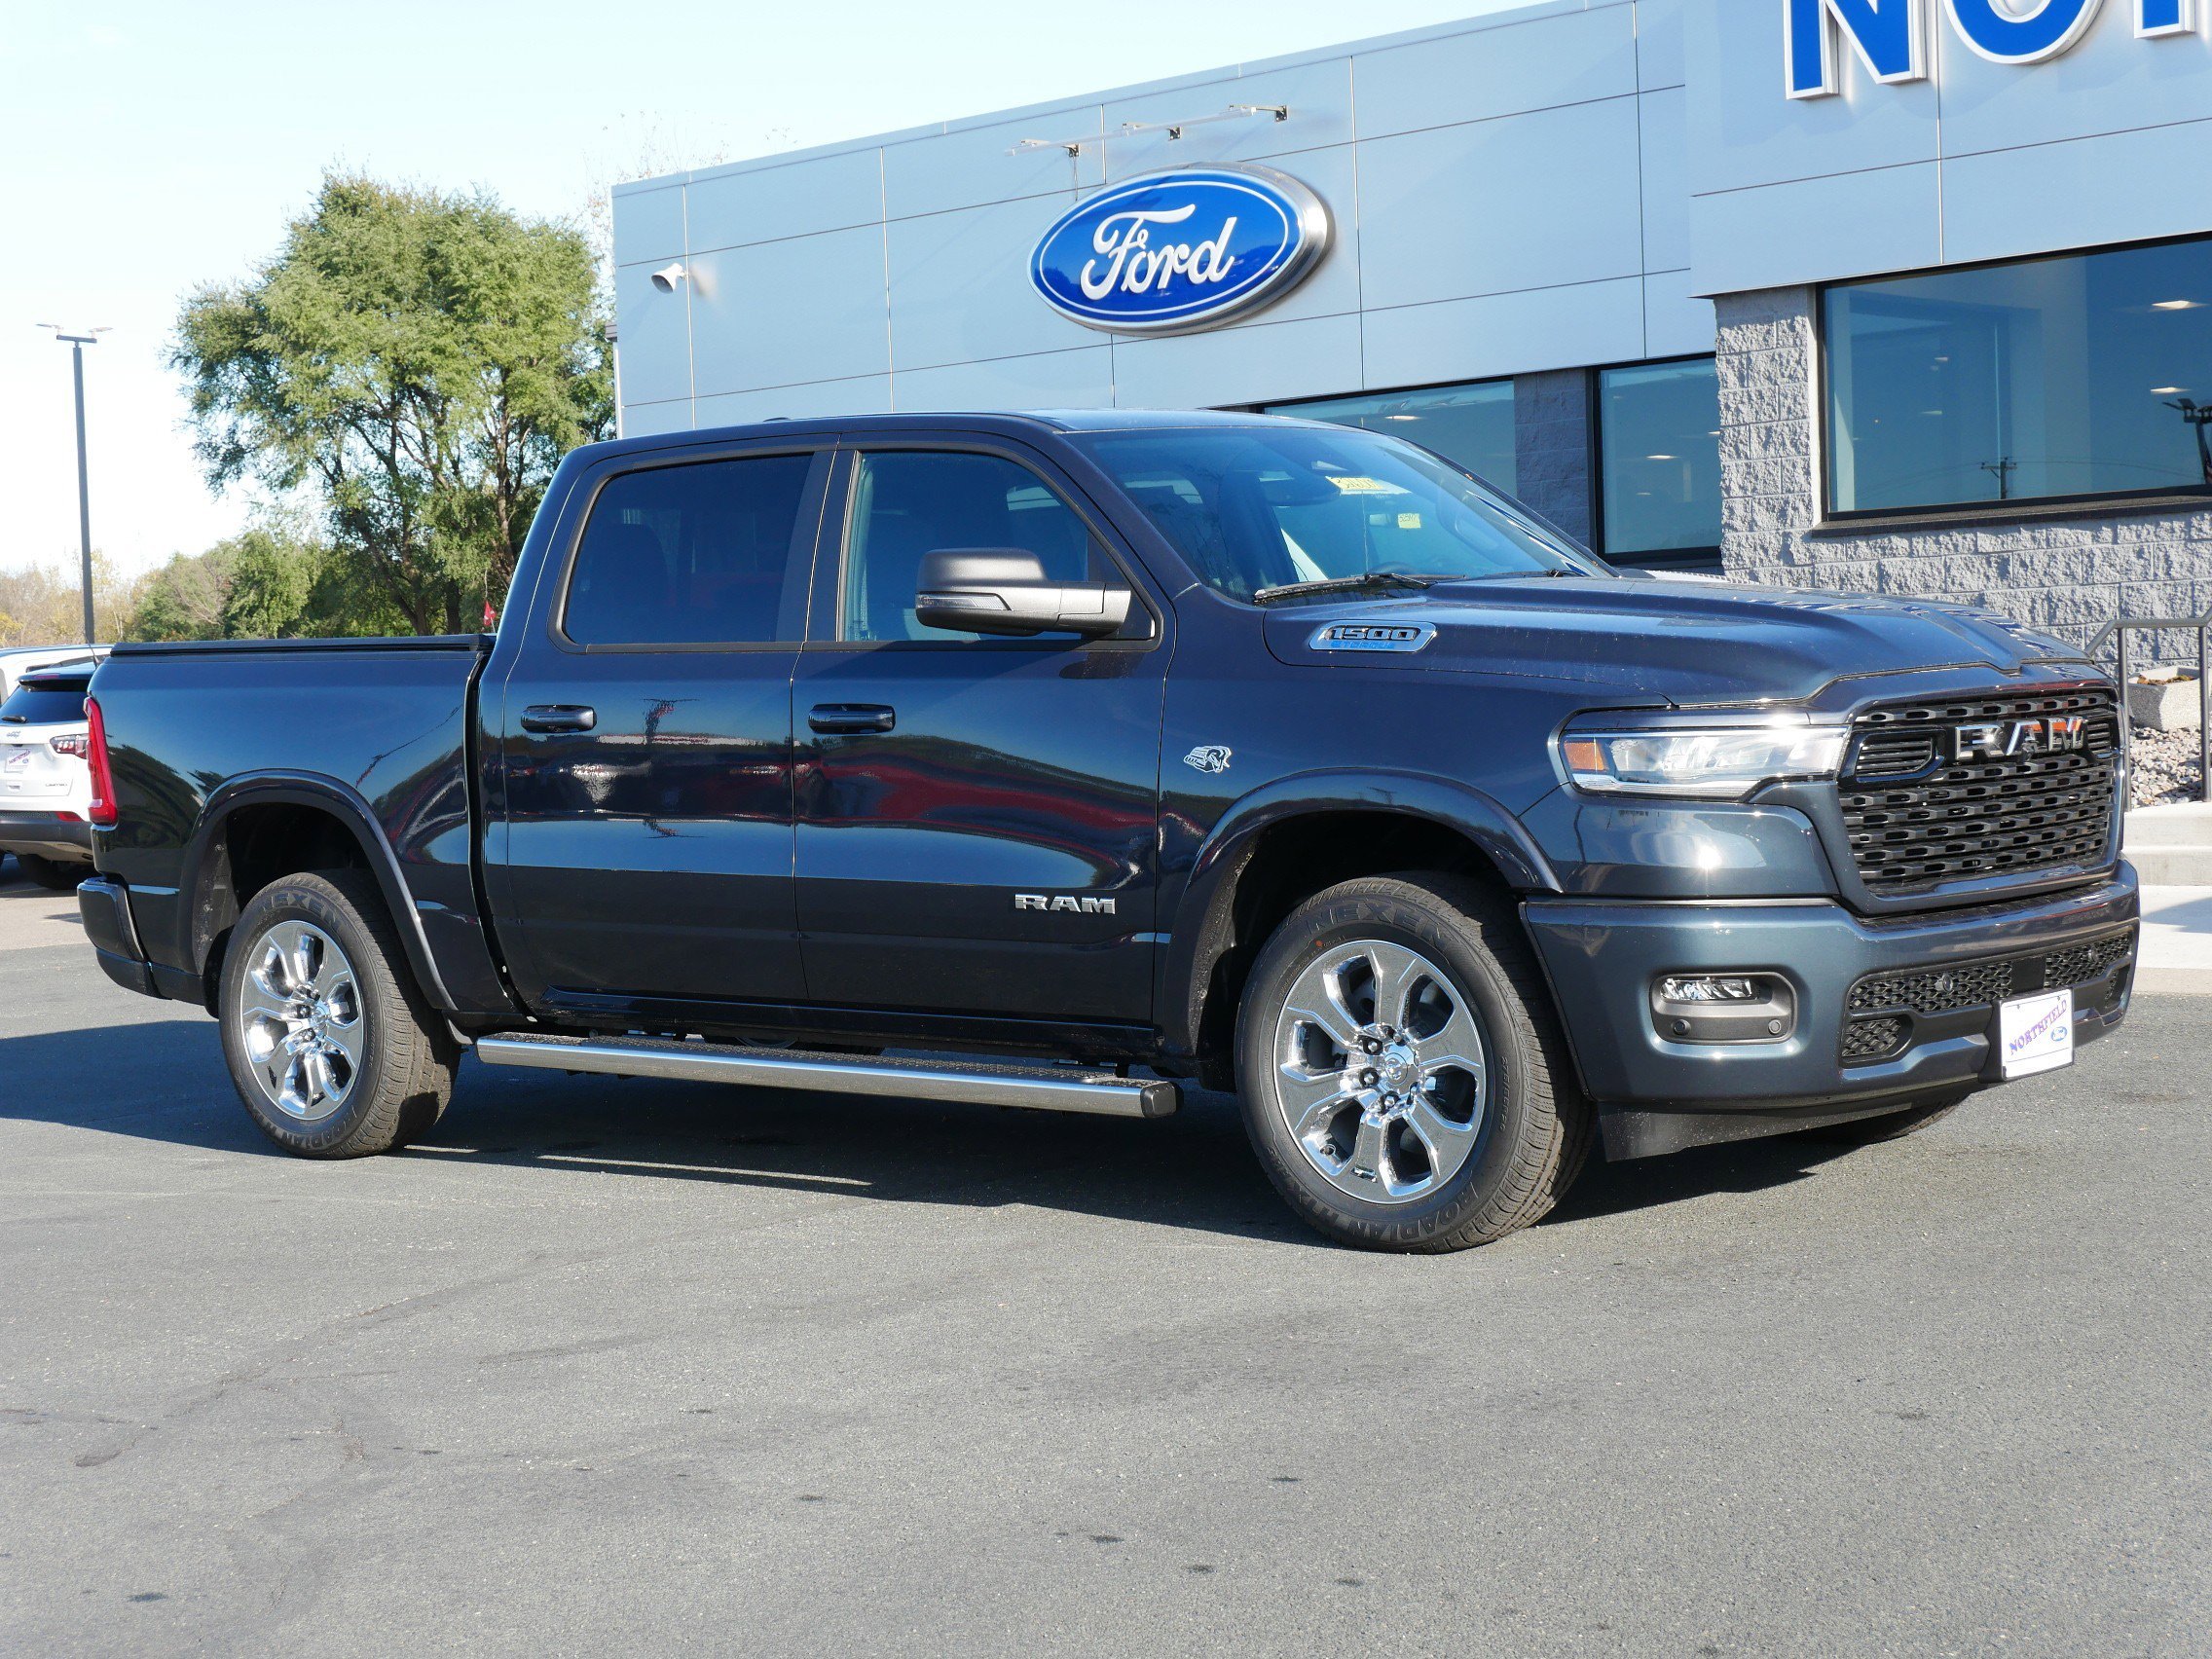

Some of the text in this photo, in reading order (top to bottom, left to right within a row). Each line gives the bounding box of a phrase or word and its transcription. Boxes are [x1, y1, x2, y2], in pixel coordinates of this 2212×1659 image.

[1080, 203, 1237, 301] Ford
[1330, 627, 1417, 640] 1500
[1955, 716, 2085, 760] RAM
[1015, 894, 1116, 914] RAM
[1303, 901, 1446, 944] NEXEN
[2009, 999, 2067, 1055] NORTHFIELD
